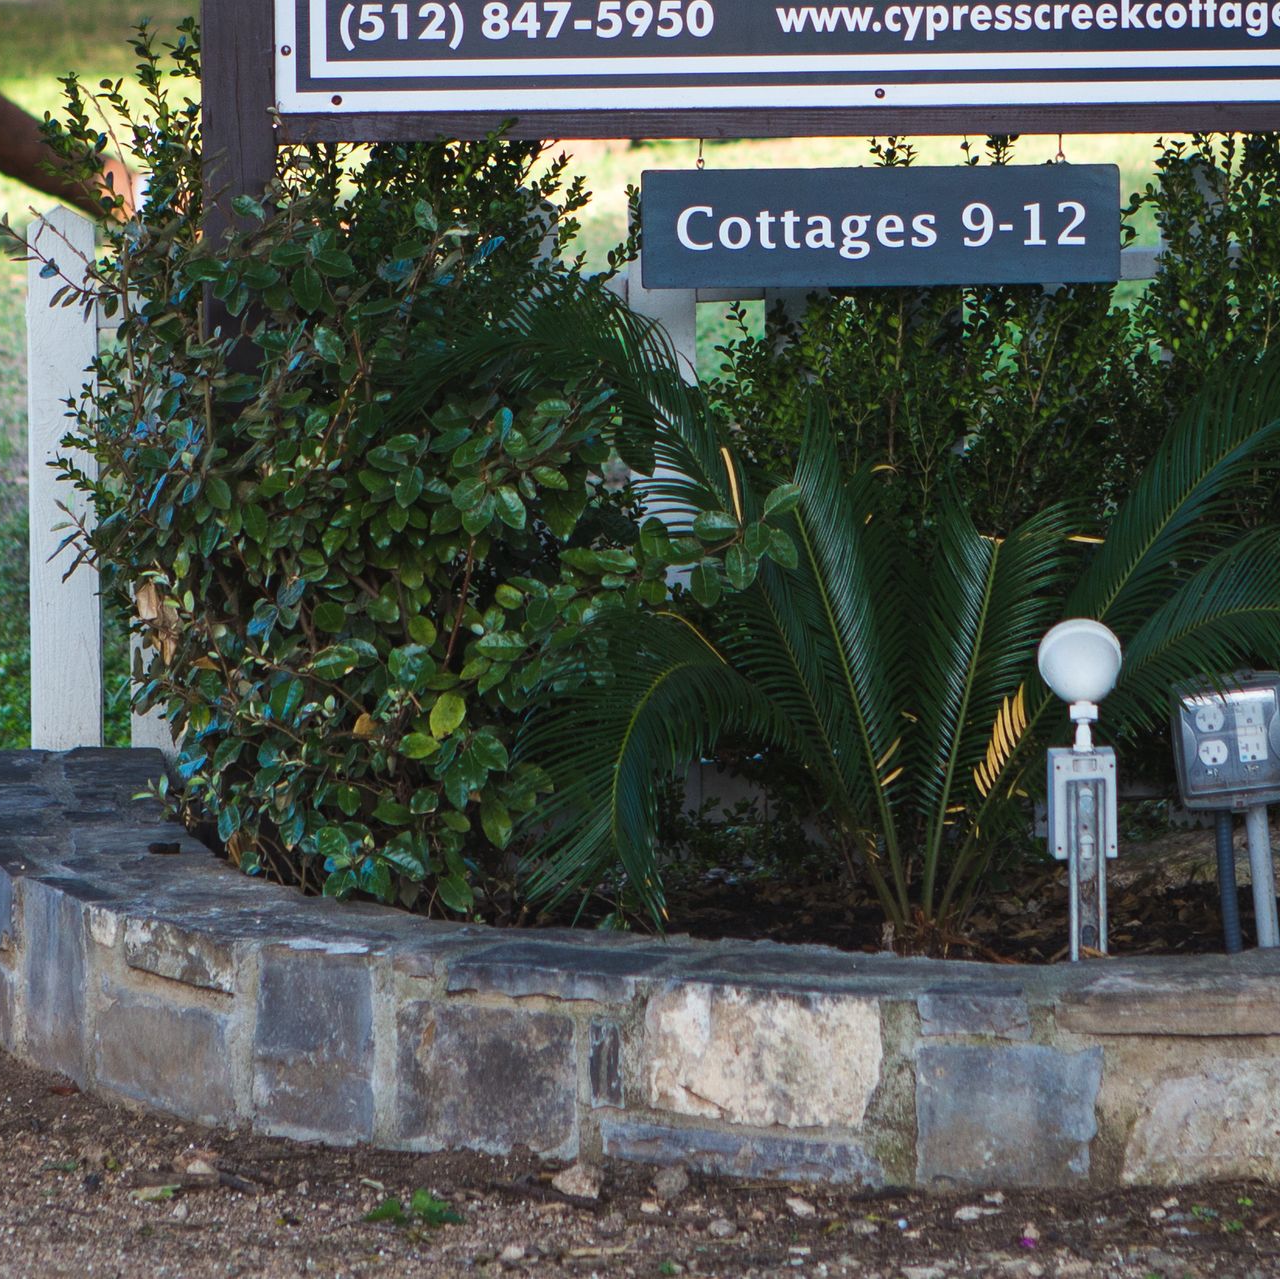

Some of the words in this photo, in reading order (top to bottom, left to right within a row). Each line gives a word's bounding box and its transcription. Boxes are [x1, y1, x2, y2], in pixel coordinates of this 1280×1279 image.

[339, 1, 464, 52] (512)
[481, 0, 715, 41] 847-5950
[676, 205, 938, 260] Cottages
[961, 201, 1087, 247] 9-12
